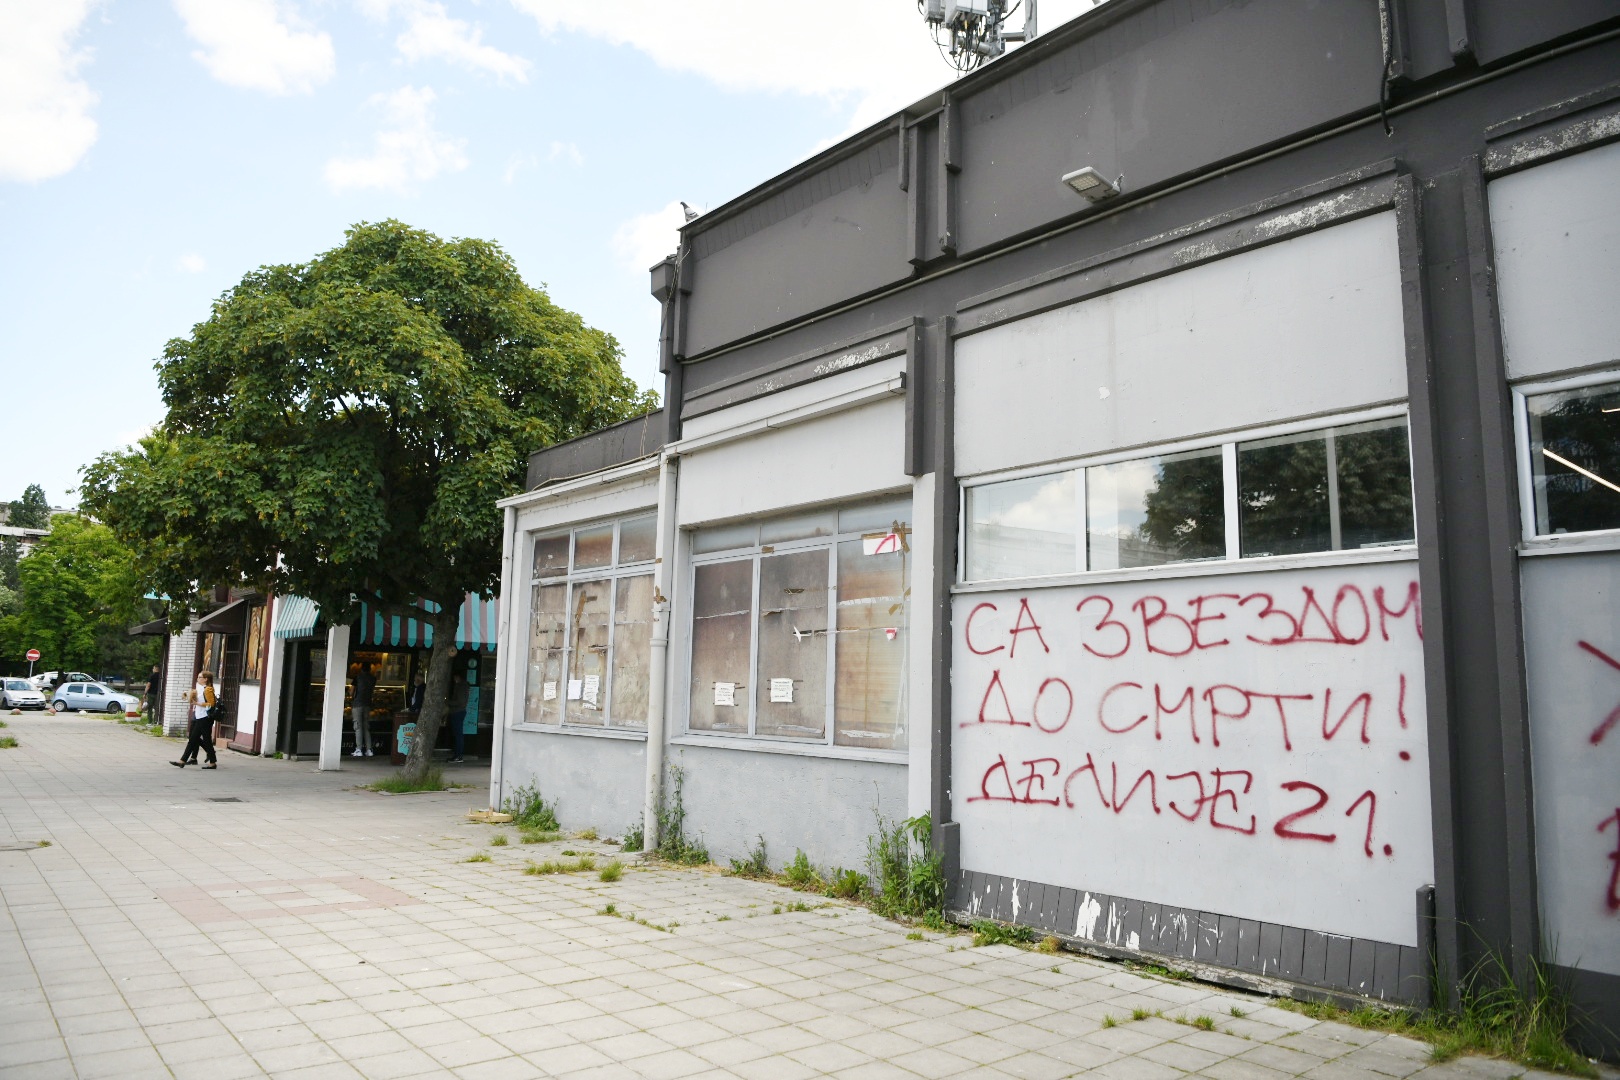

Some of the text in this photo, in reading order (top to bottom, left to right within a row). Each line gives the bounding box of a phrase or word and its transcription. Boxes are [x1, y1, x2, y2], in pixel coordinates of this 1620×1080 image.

[965, 581, 1424, 660] СА ЗВЕЗДОМ
[959, 669, 1412, 762] ДО СМРТИ!
[966, 753, 1258, 837] ДЕЛИЈЕ
